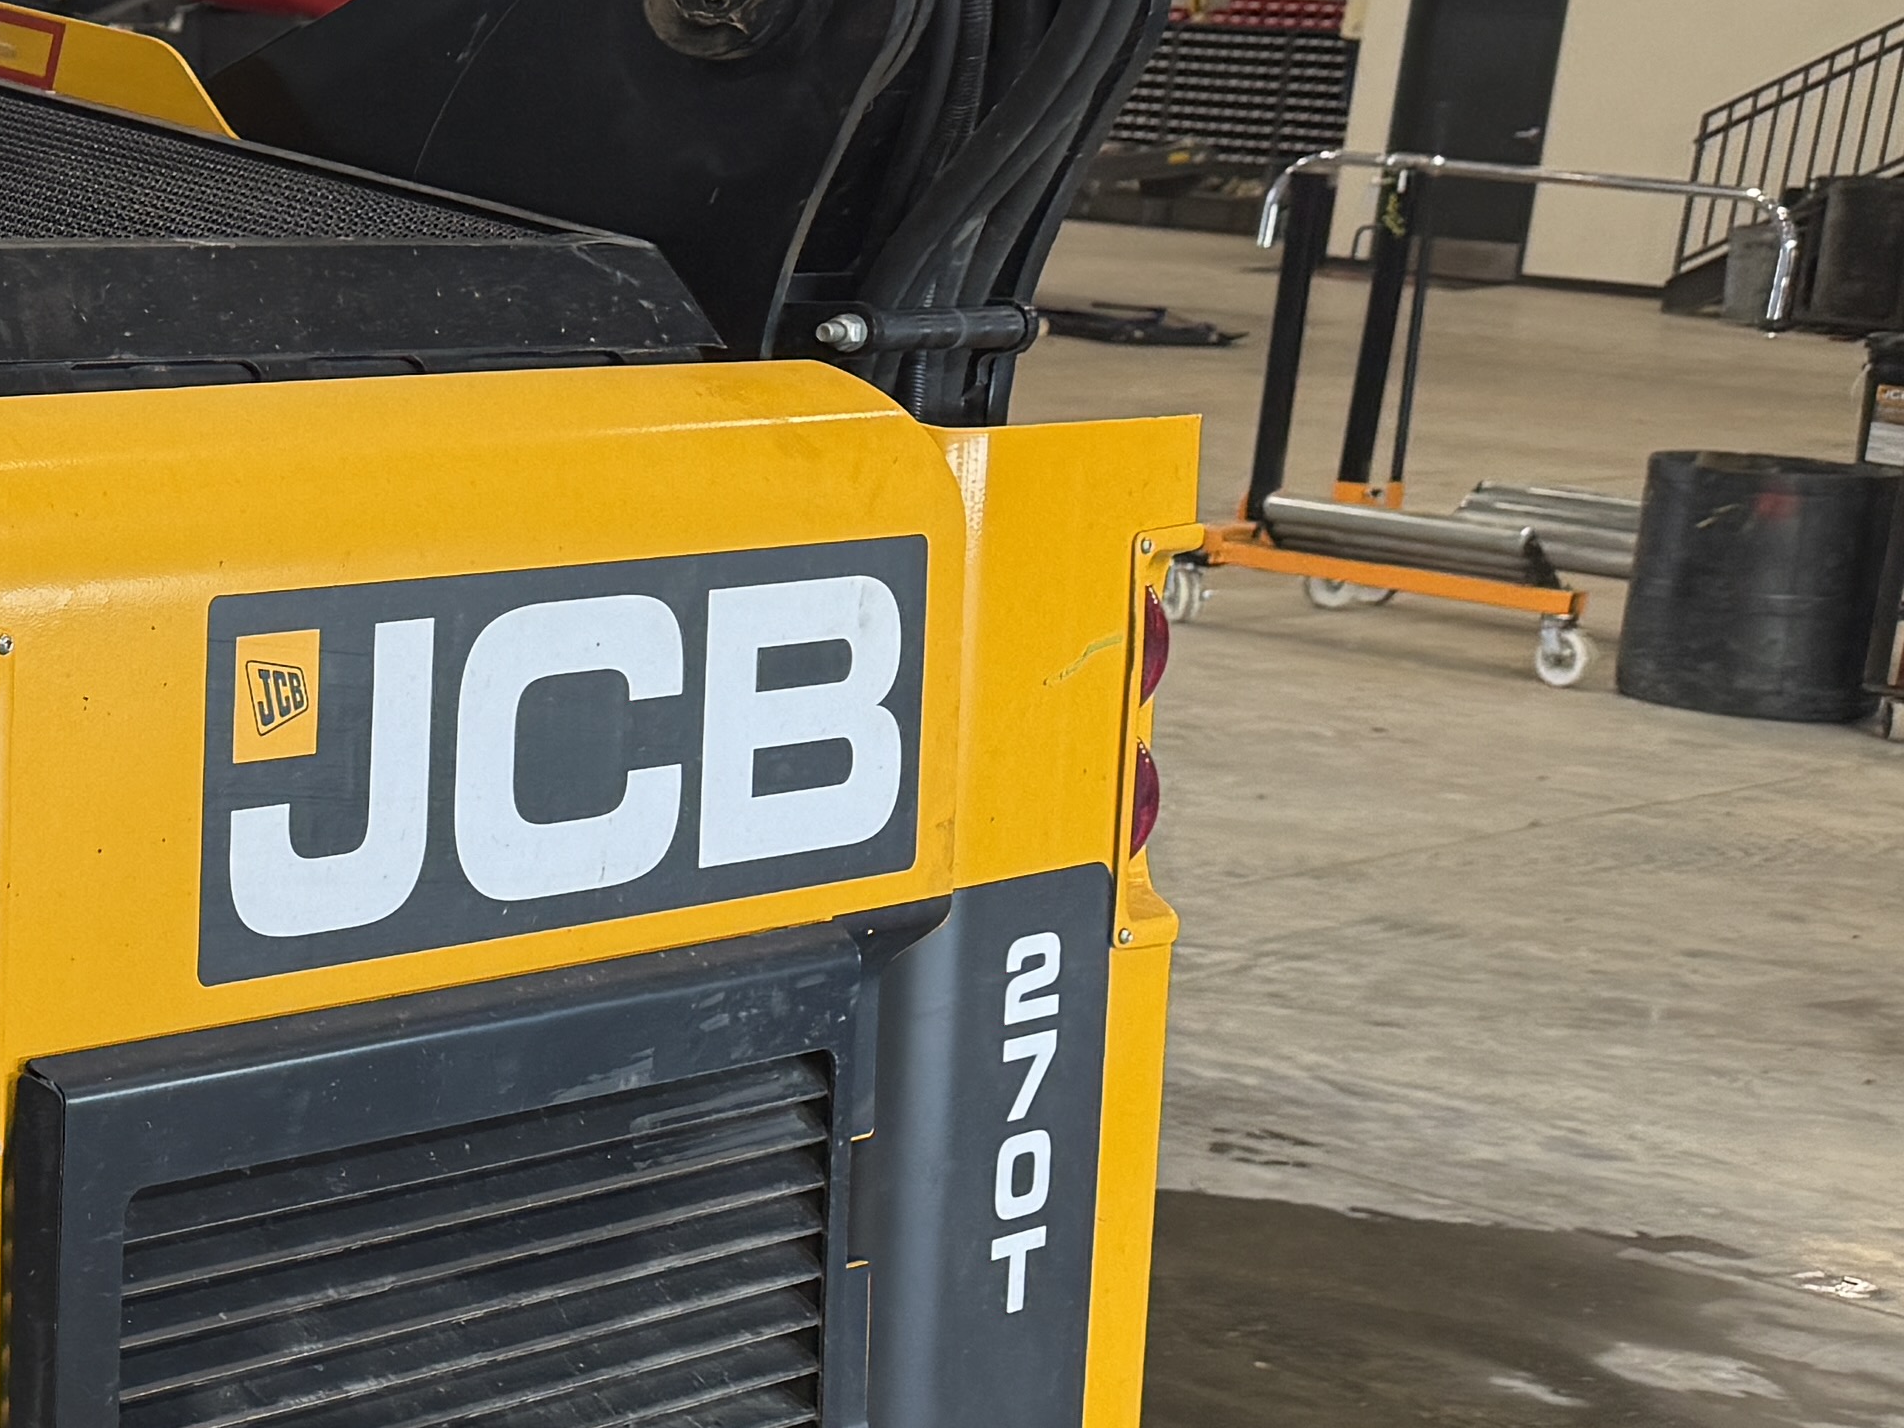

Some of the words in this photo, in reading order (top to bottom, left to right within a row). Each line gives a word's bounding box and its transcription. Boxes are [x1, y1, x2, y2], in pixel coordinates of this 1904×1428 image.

[229, 575, 902, 937] JCB
[257, 668, 306, 727] JCB
[991, 931, 1061, 1314] 270T
